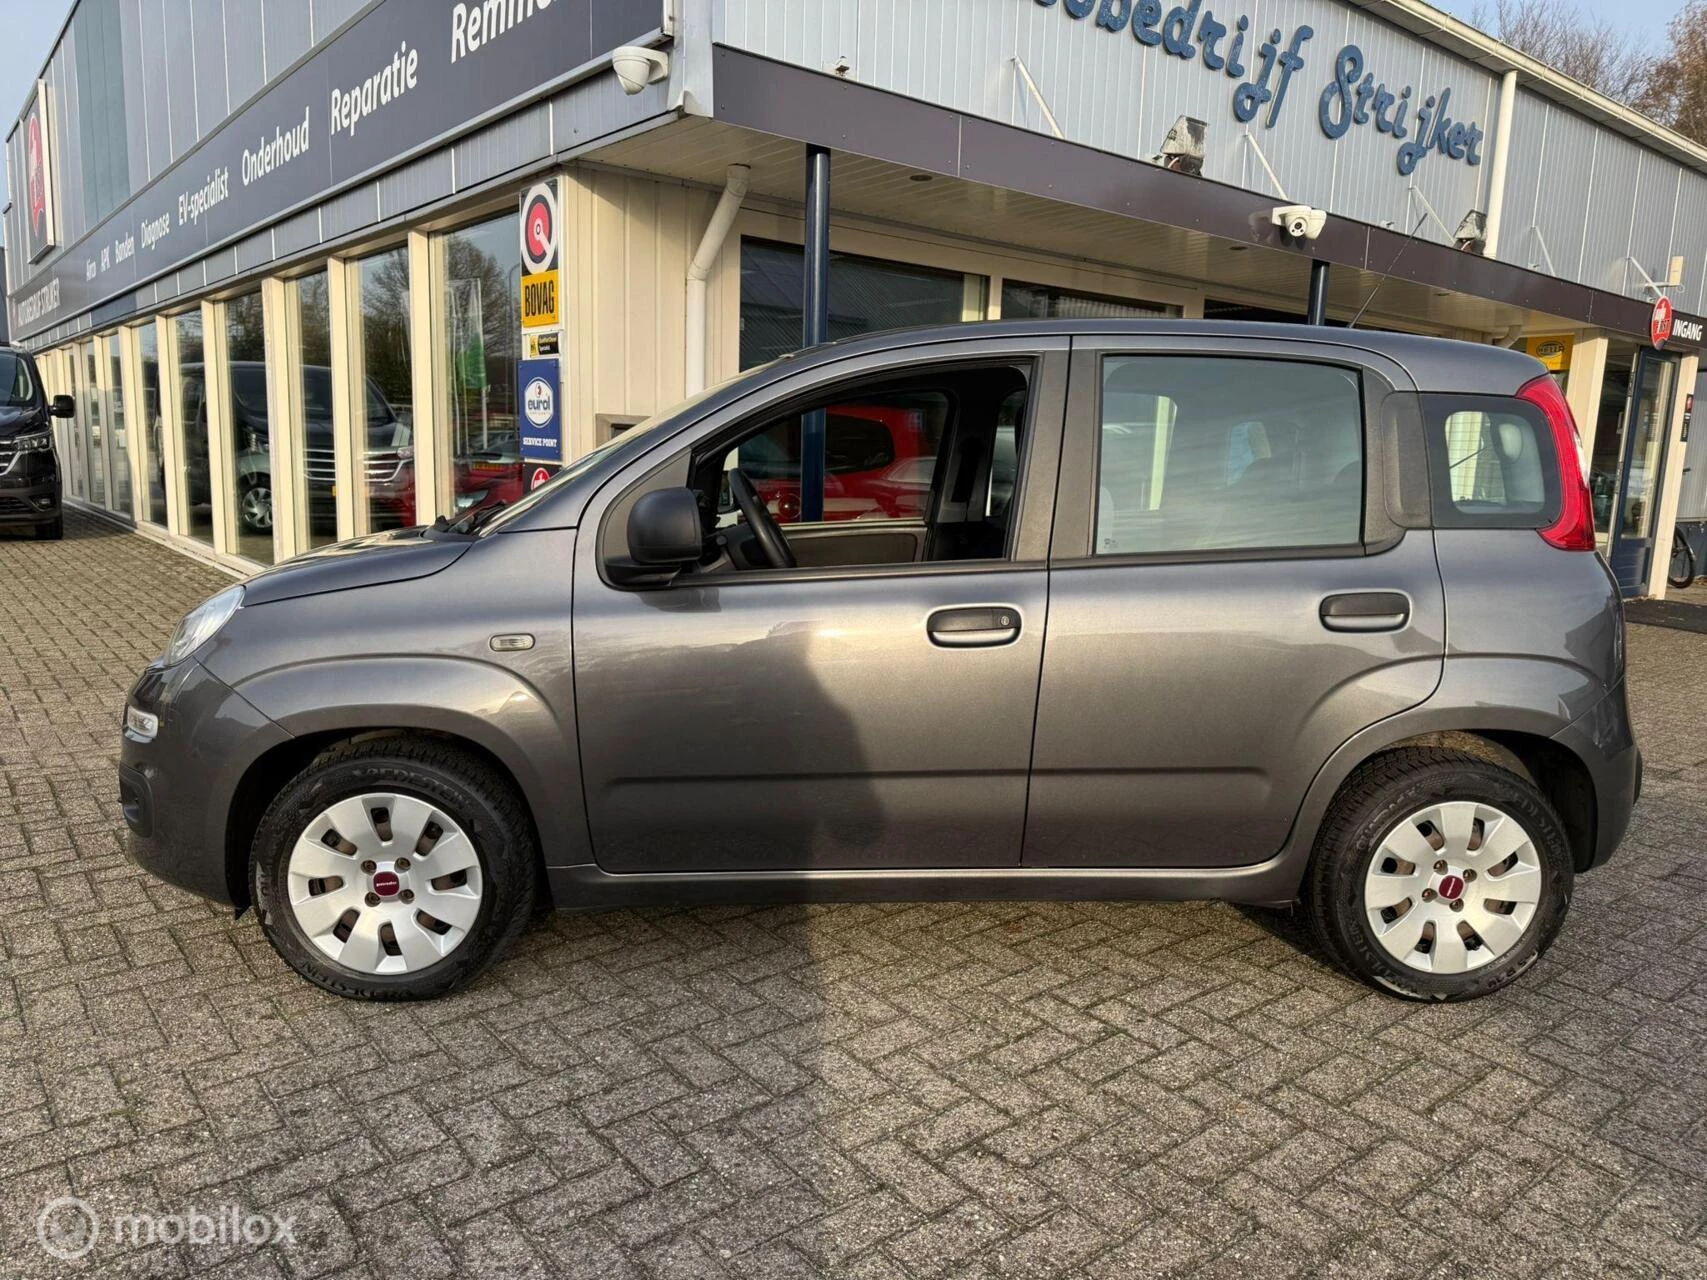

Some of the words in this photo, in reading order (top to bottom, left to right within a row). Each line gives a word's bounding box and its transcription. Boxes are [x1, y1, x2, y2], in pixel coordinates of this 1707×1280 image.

[1319, 44, 1484, 176] Strijker
[100, 245, 111, 272] APK
[115, 231, 135, 264] Banden
[140, 212, 170, 250] Diagnose
[178, 166, 229, 226] EV-specialist
[242, 105, 310, 187] Onderhoud
[330, 40, 418, 137] Reparatie
[524, 280, 555, 317] BOVAG
[1672, 318, 1703, 342] INGANG
[528, 396, 551, 411] eurol
[522, 437, 542, 447] SERVICE
[543, 438, 558, 448] POINT
